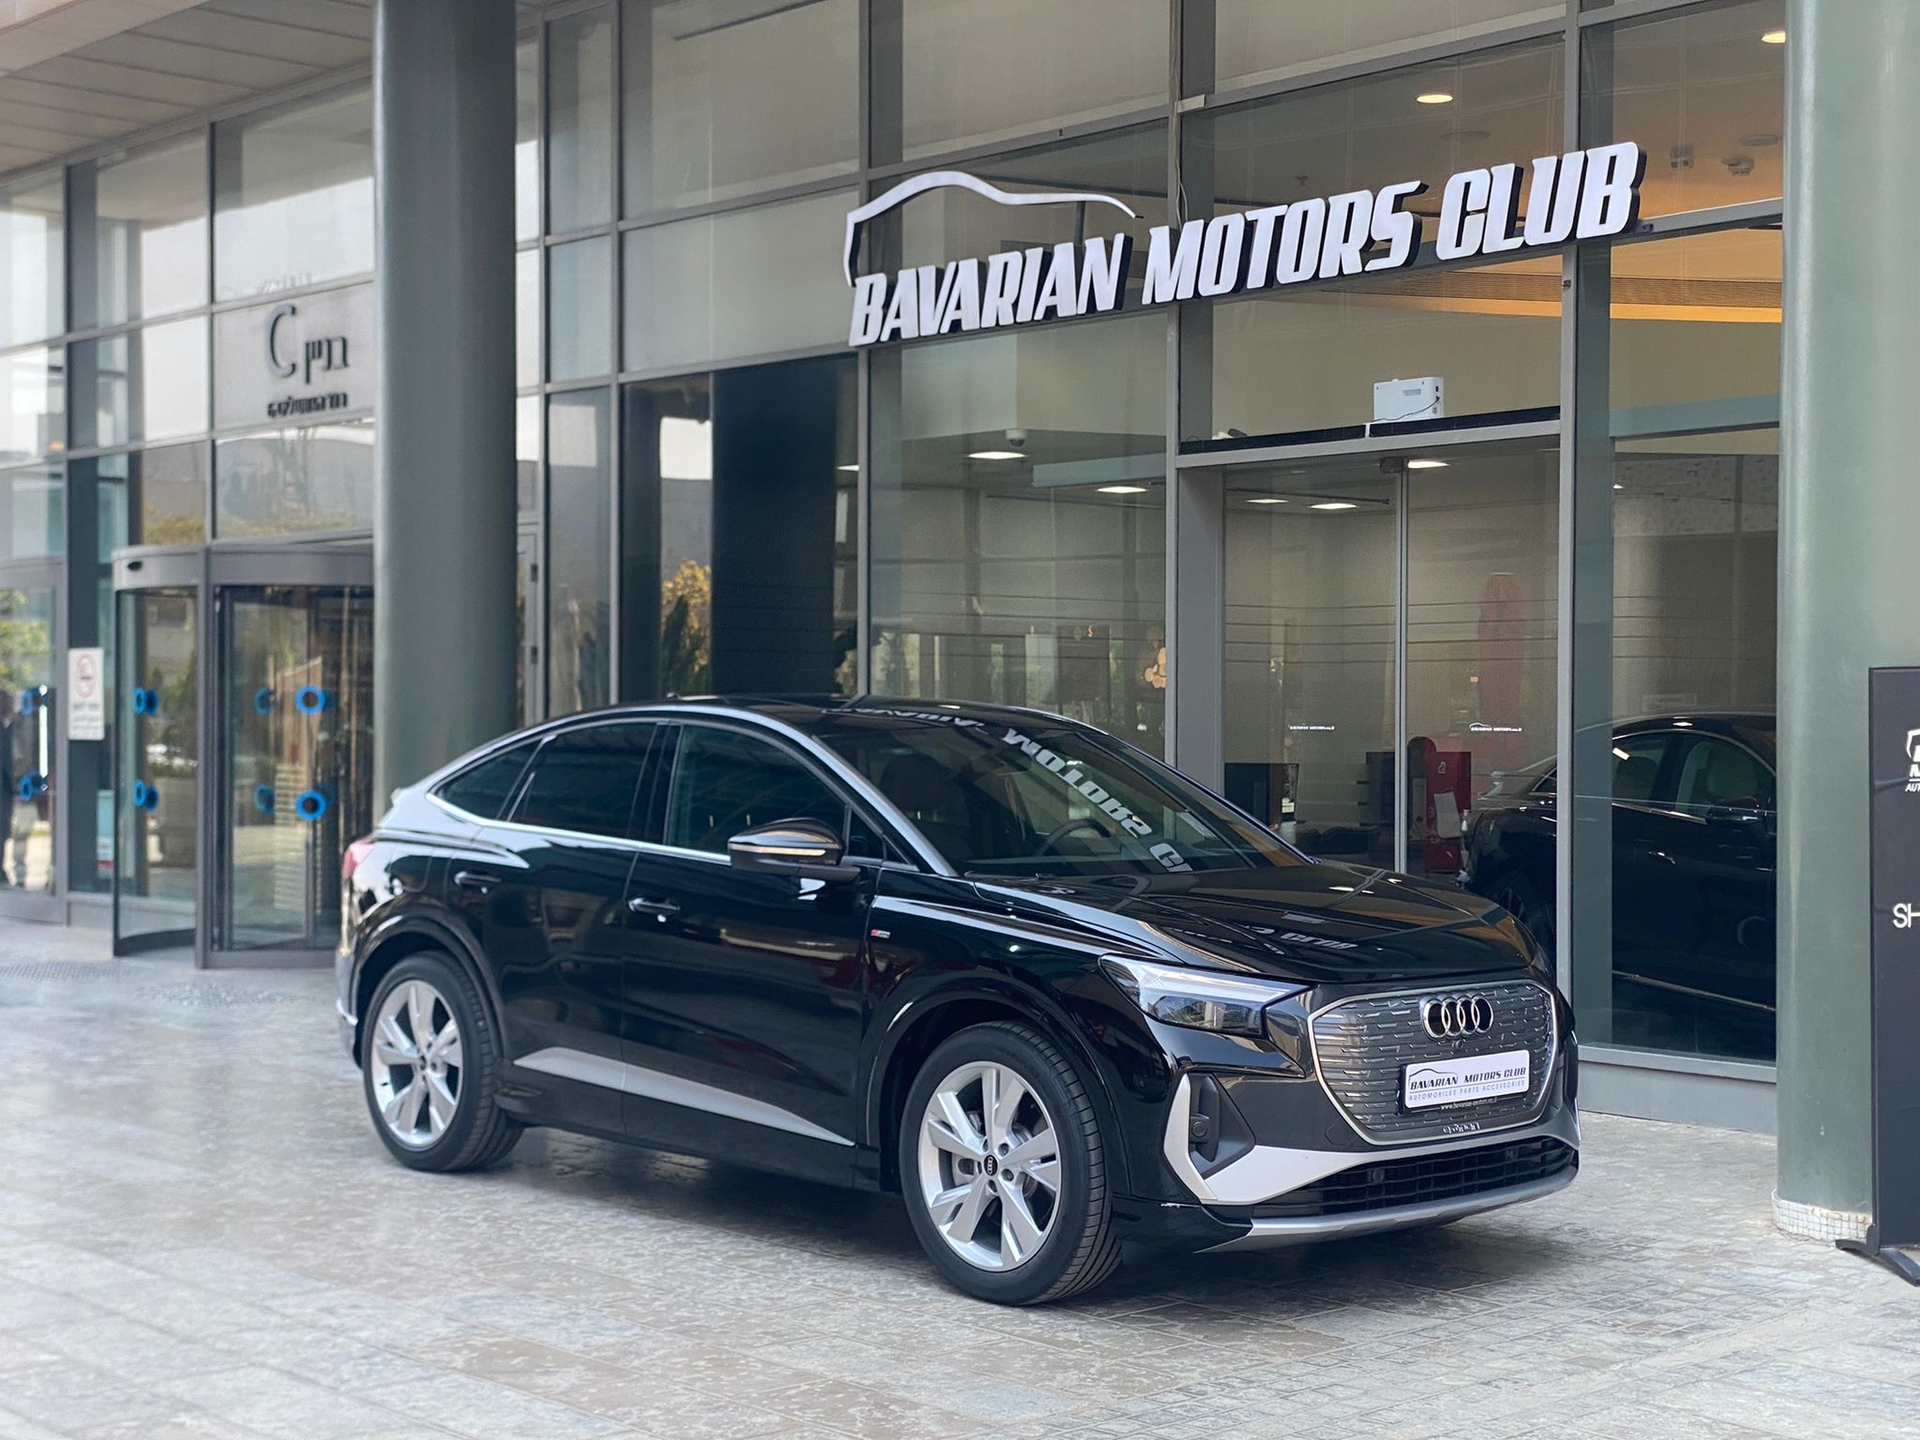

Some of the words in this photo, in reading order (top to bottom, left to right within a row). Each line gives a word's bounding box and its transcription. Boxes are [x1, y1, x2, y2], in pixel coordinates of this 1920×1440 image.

[848, 232, 1130, 348] BAVARIAN
[1141, 179, 1426, 306] MOTORS
[1435, 140, 1644, 262] CLUB
[264, 303, 296, 379] C
[1409, 1089, 1457, 1101] AUTOMOBILES
[1459, 1086, 1480, 1094] PARTS
[1410, 1076, 1459, 1090] BAVARIAN
[1463, 1070, 1501, 1083] MOTORS
[1503, 1067, 1526, 1078] CLUB
